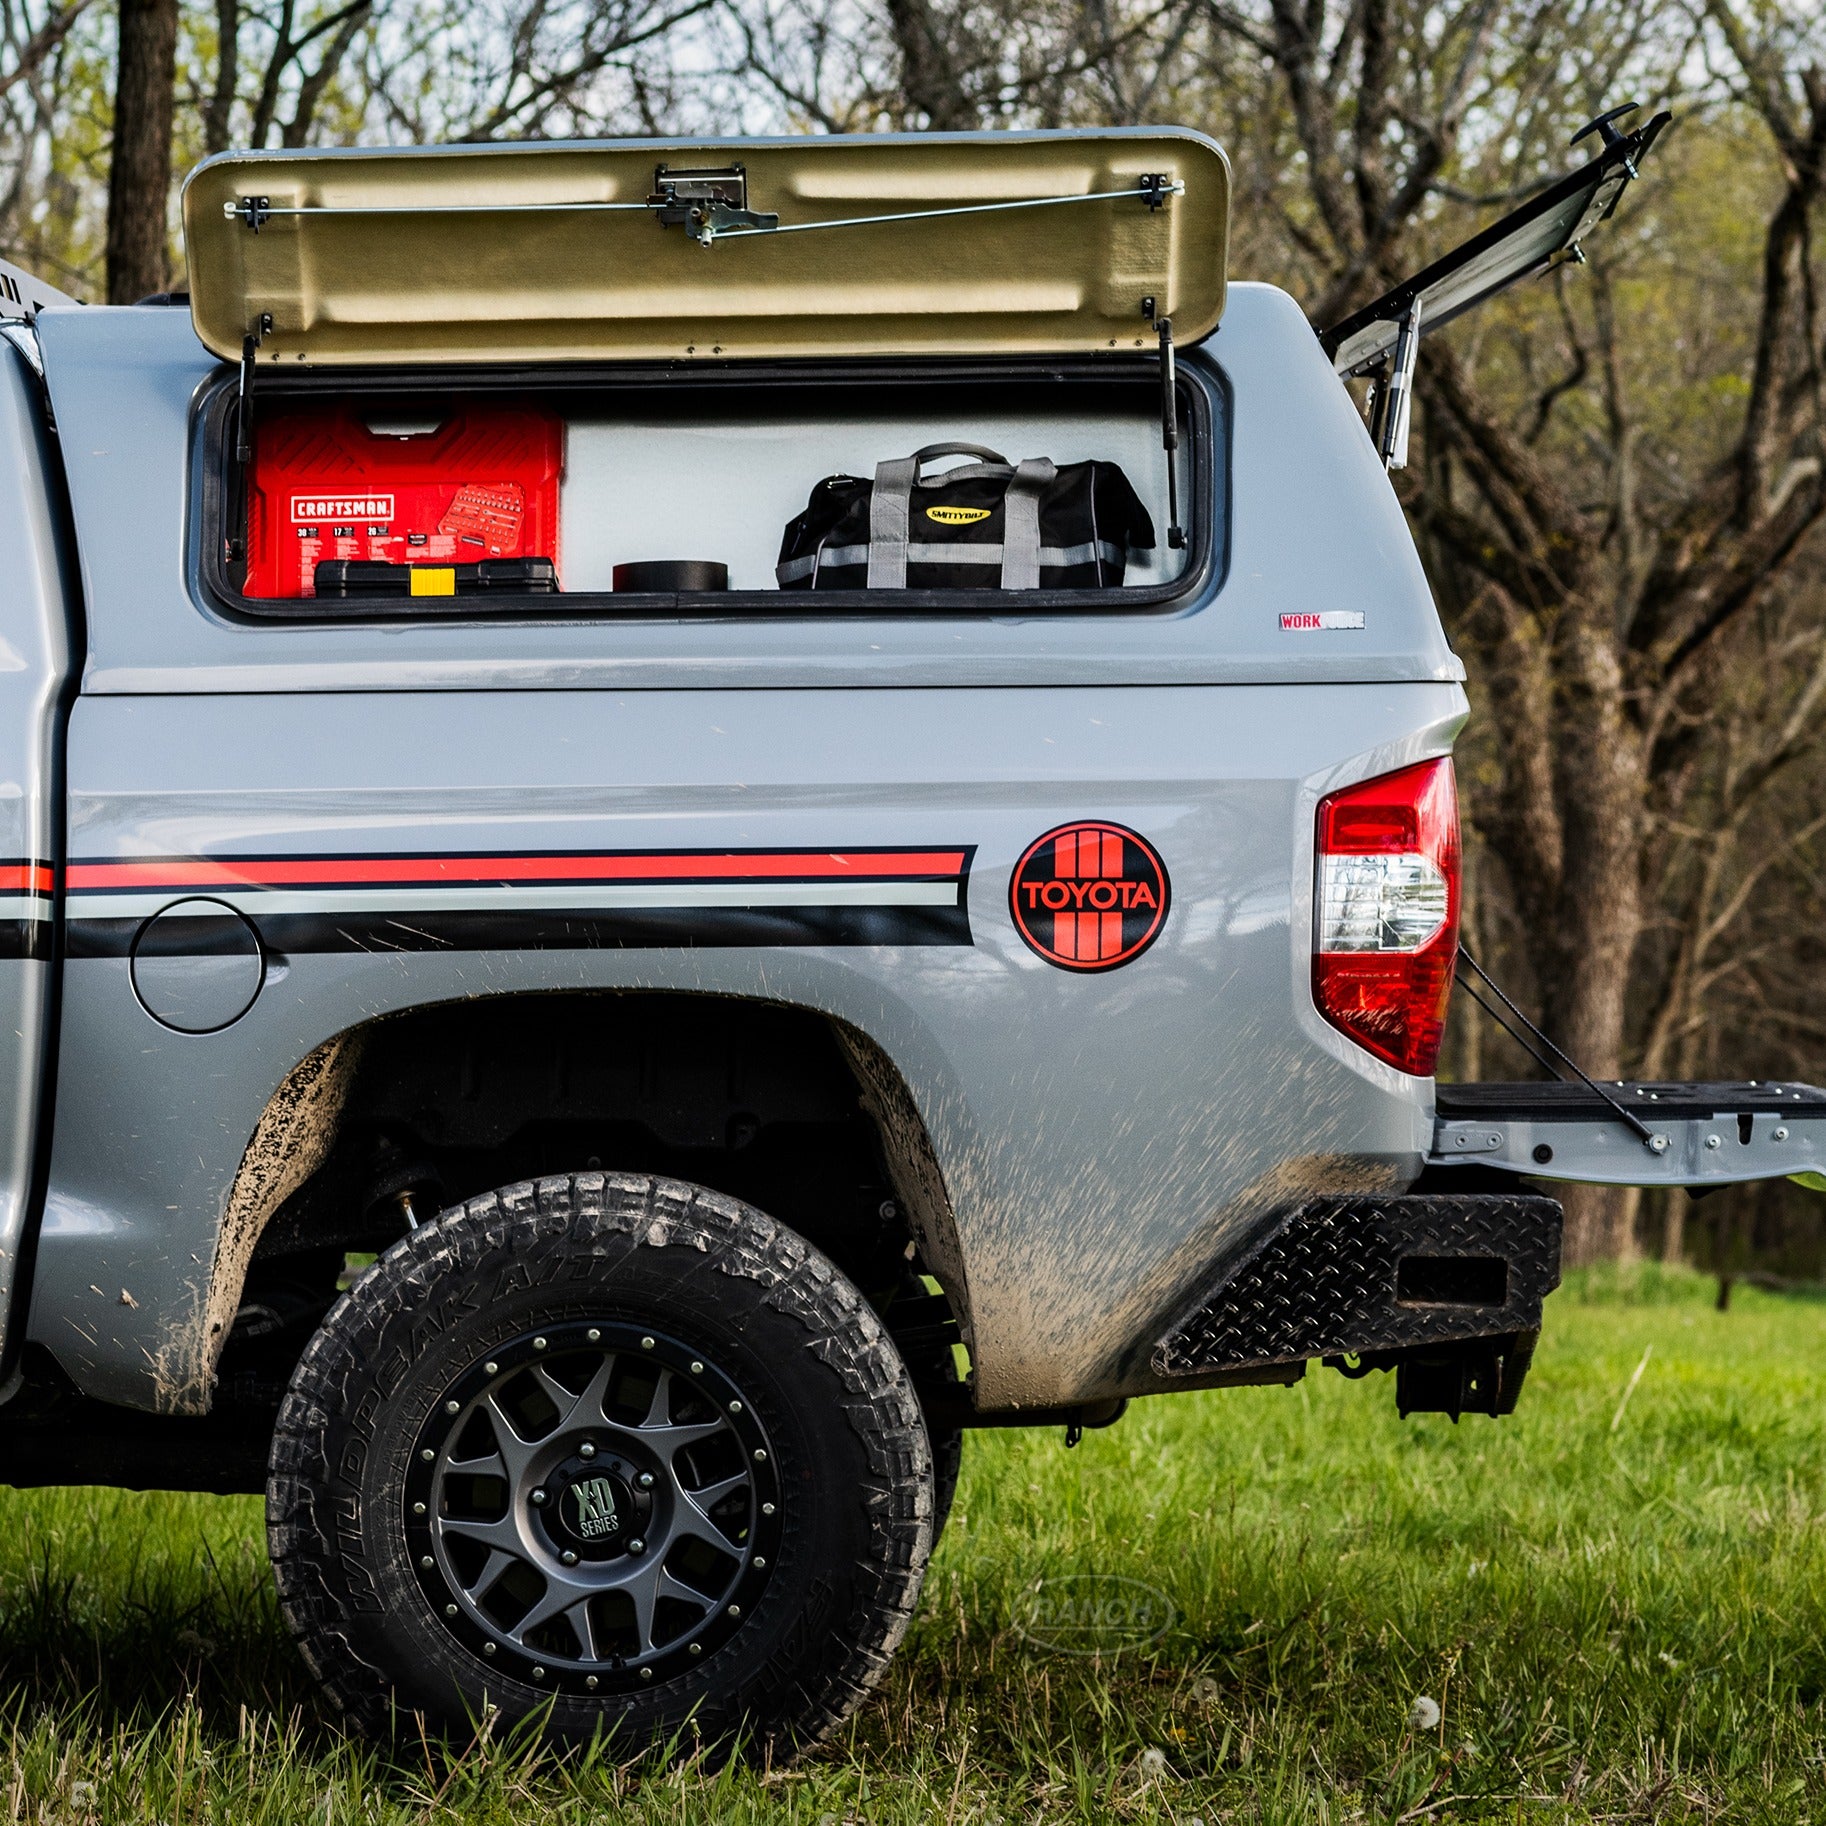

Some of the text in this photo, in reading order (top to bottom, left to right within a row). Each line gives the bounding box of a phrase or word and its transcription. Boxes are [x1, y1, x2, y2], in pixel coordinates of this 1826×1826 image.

[298, 502, 386, 516] CRAFTSMAN
[1282, 615, 1321, 628] WORK
[1022, 881, 1158, 909] TOYOTA
[336, 1283, 480, 1613] WILDPEAK
[571, 1477, 615, 1521] XD
[580, 1515, 619, 1538] SERIES
